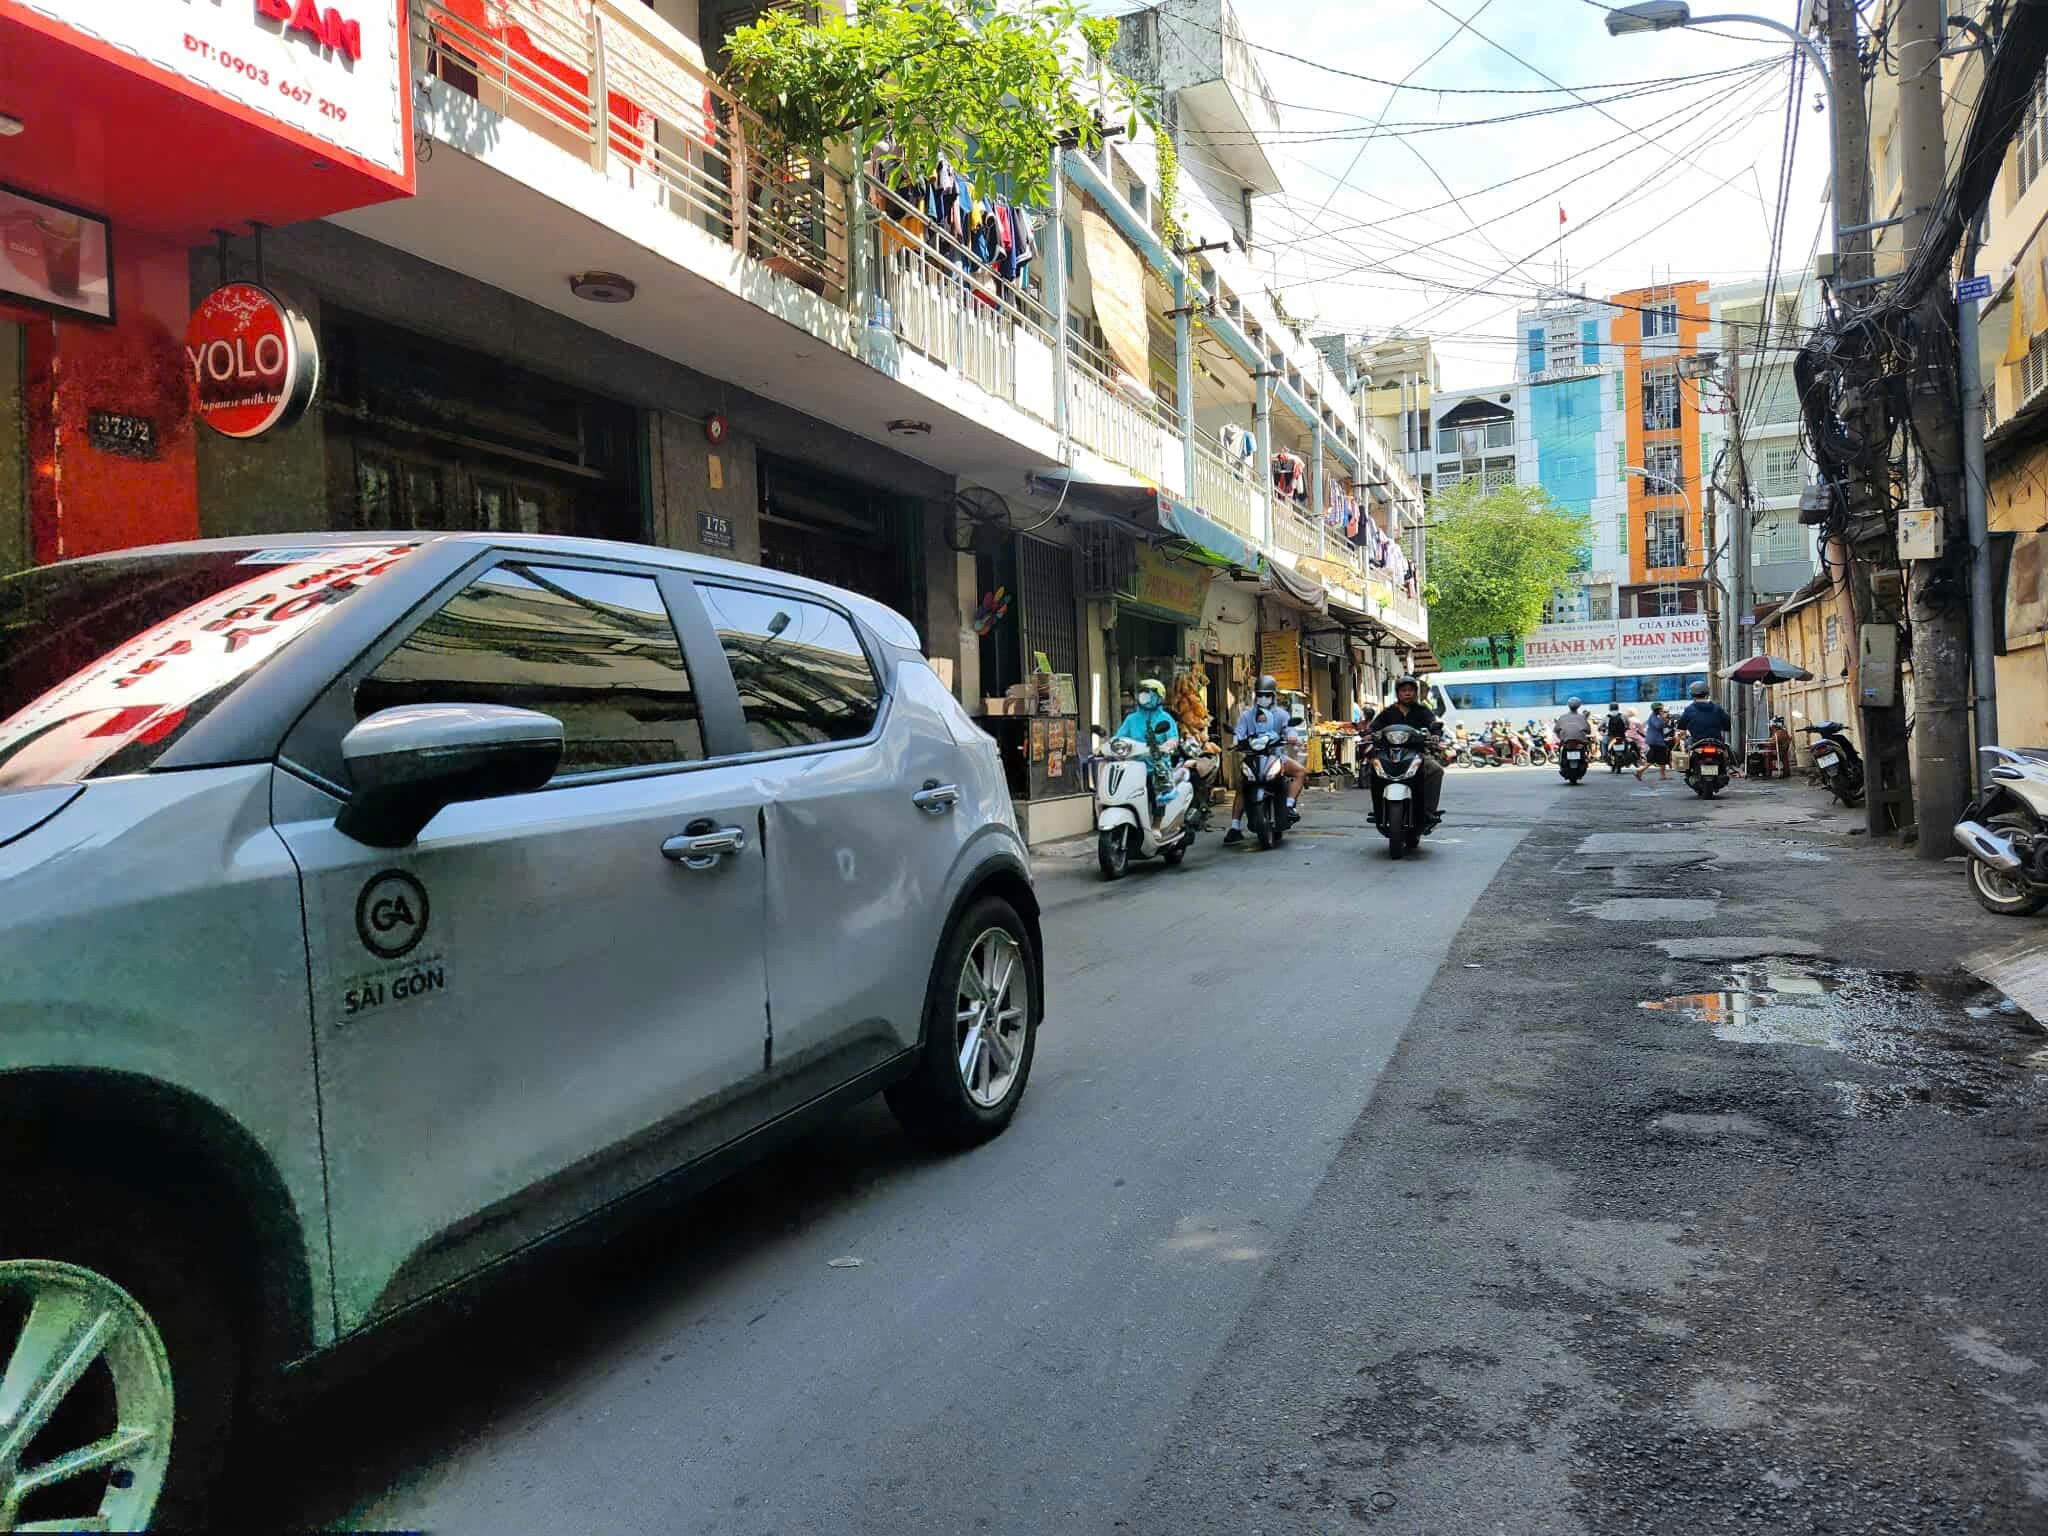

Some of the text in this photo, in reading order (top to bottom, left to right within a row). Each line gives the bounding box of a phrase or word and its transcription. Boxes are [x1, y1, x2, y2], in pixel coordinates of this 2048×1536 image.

[279, 79, 312, 105] 667
[319, 97, 348, 122] 219
[185, 333, 284, 383] YOLO
[241, 392, 265, 406] milk
[98, 415, 149, 441] 373/2
[704, 515, 728, 533] 175
